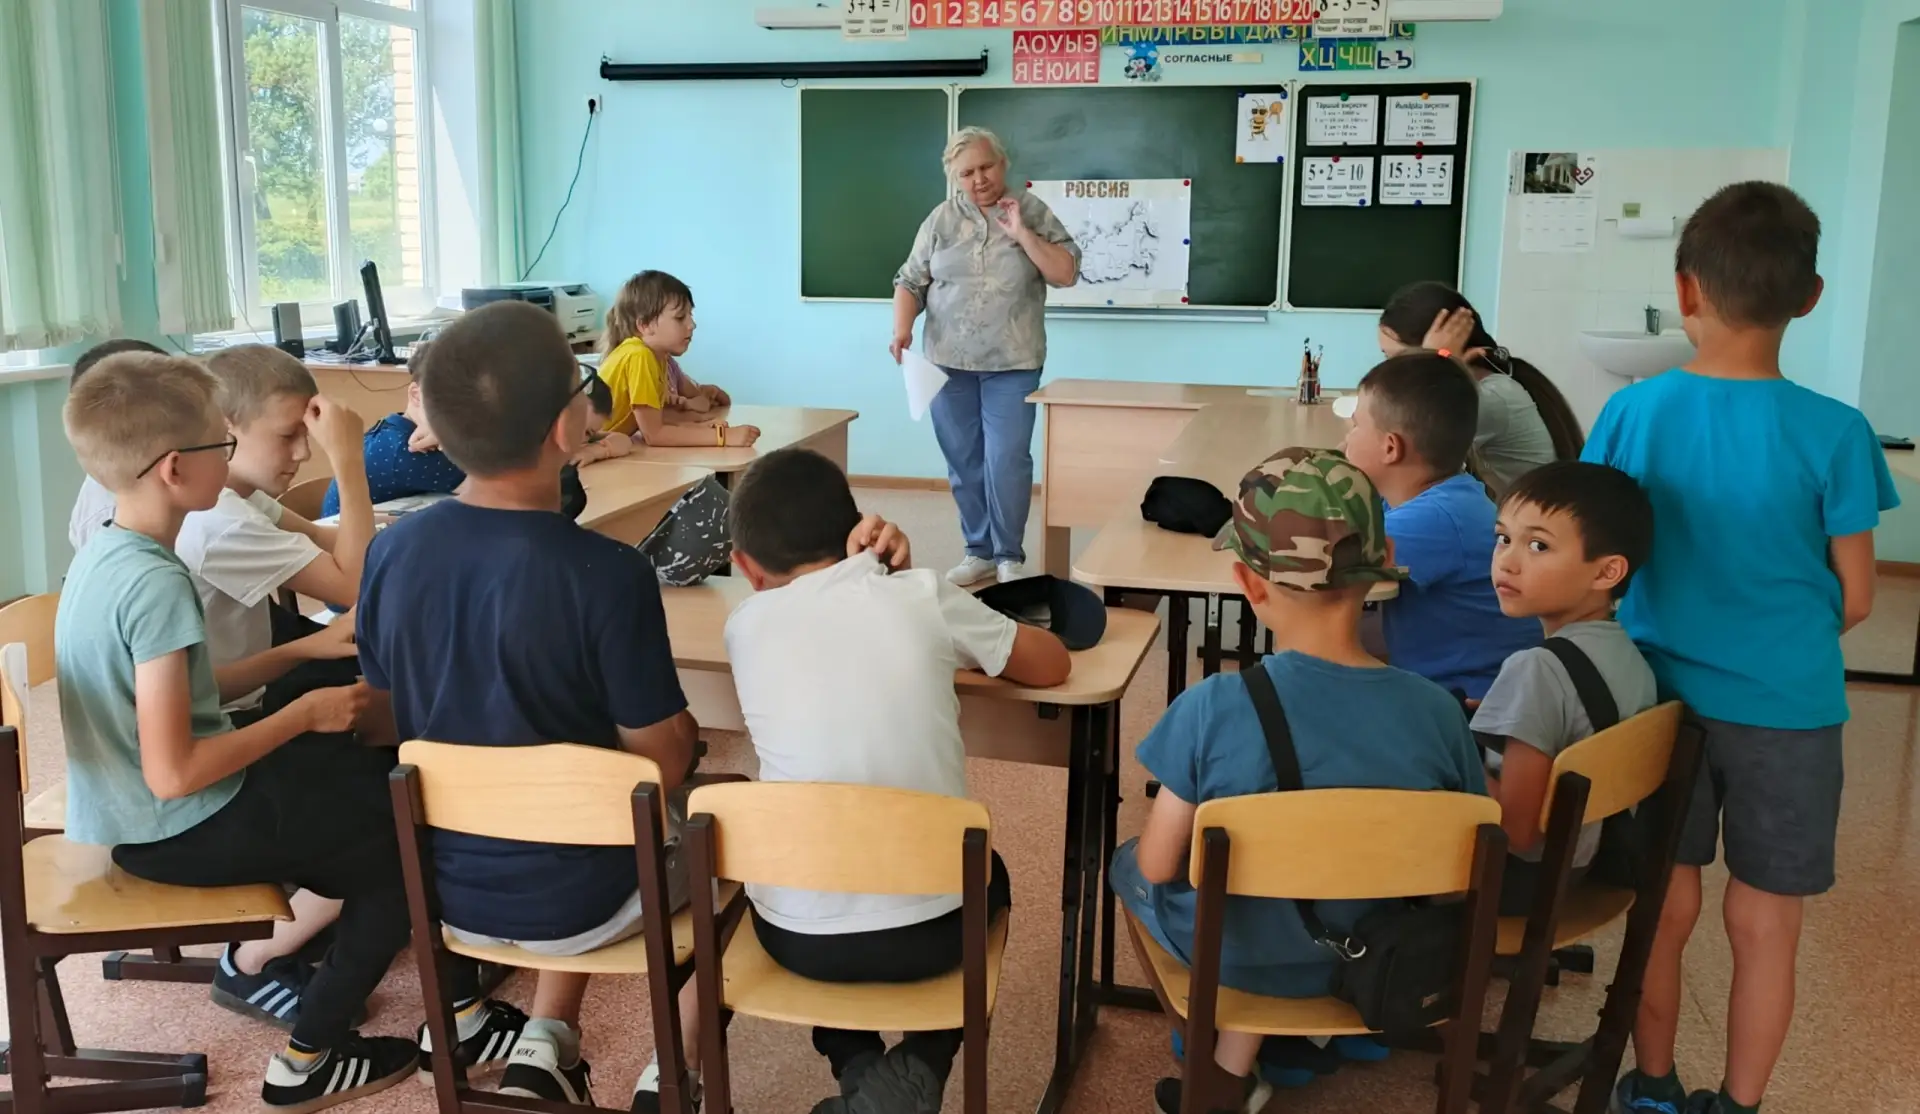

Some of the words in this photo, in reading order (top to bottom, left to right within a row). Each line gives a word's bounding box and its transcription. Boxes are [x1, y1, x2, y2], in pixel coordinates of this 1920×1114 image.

[1164, 53, 1233, 64] СОГЛАСНЫЕ
[1308, 164, 1316, 181] 5
[1326, 163, 1334, 180] 2
[1350, 163, 1364, 181] 10
[1388, 162, 1403, 179] 15
[1415, 162, 1423, 179] 3
[1439, 162, 1447, 179] 5
[1065, 181, 1130, 198] РОССИЯ
[514, 1047, 537, 1058] NIKE
